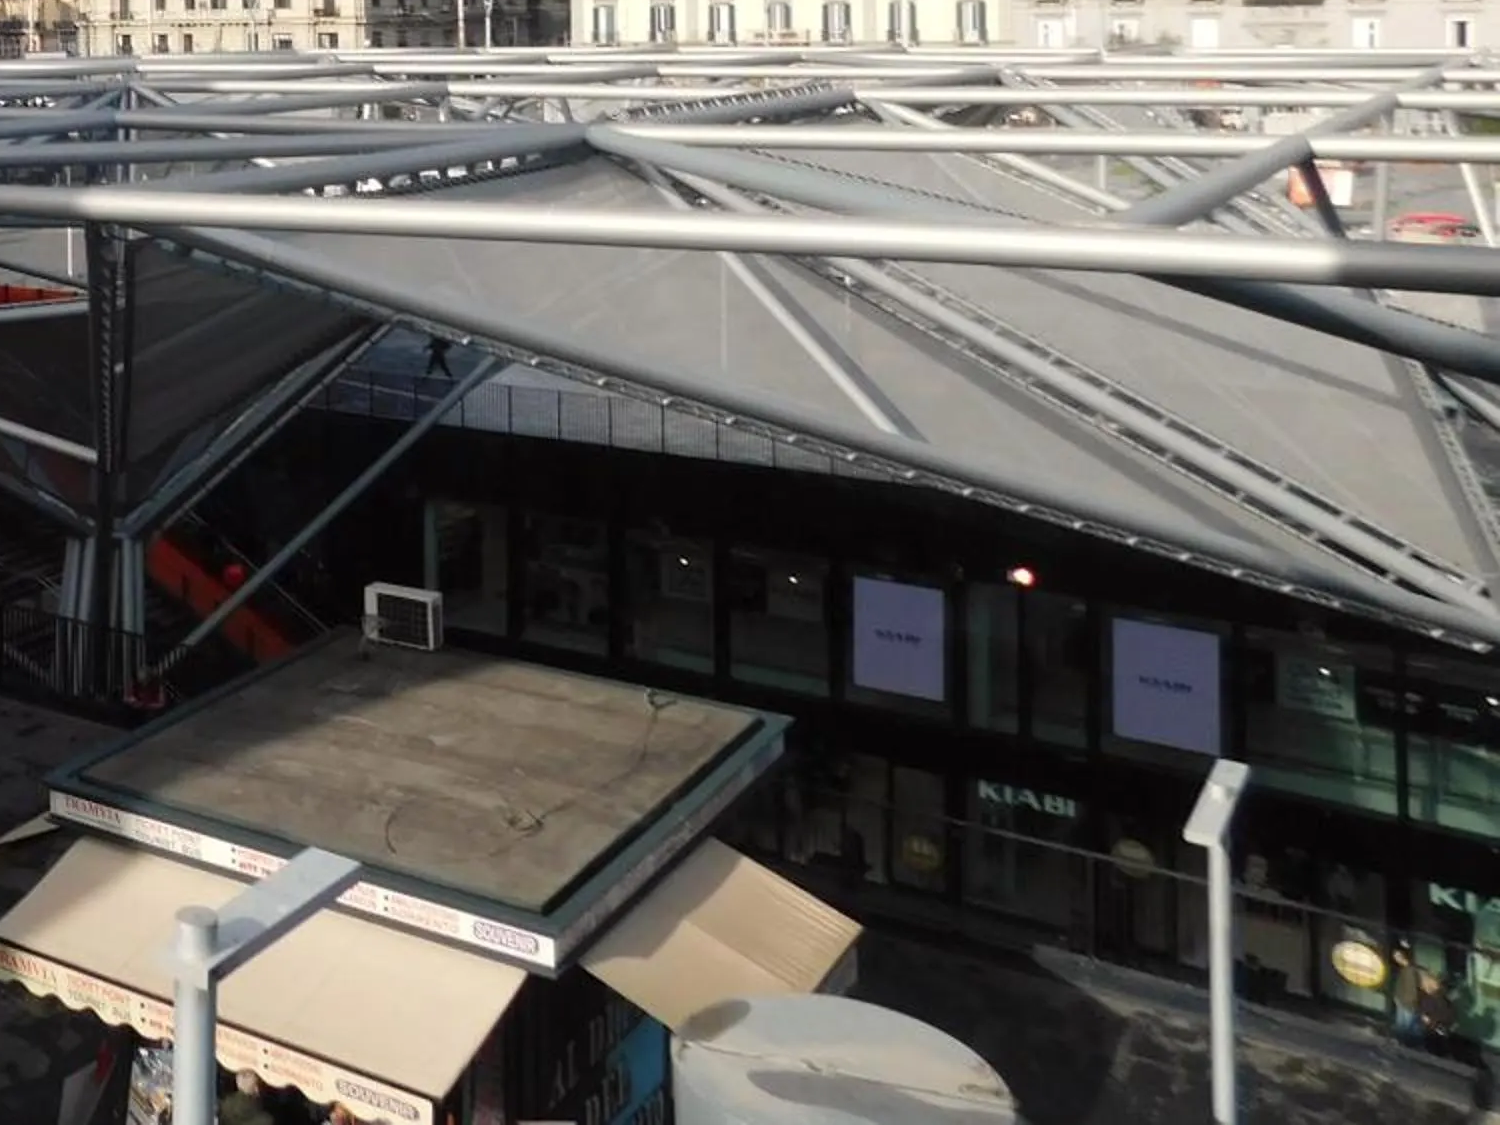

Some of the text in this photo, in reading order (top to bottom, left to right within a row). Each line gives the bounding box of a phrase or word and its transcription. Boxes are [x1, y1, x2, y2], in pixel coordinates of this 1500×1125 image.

[978, 778, 1076, 818] KIABI
[474, 921, 538, 955] SOUVENIR
[338, 1079, 420, 1120] SOUVENIR
